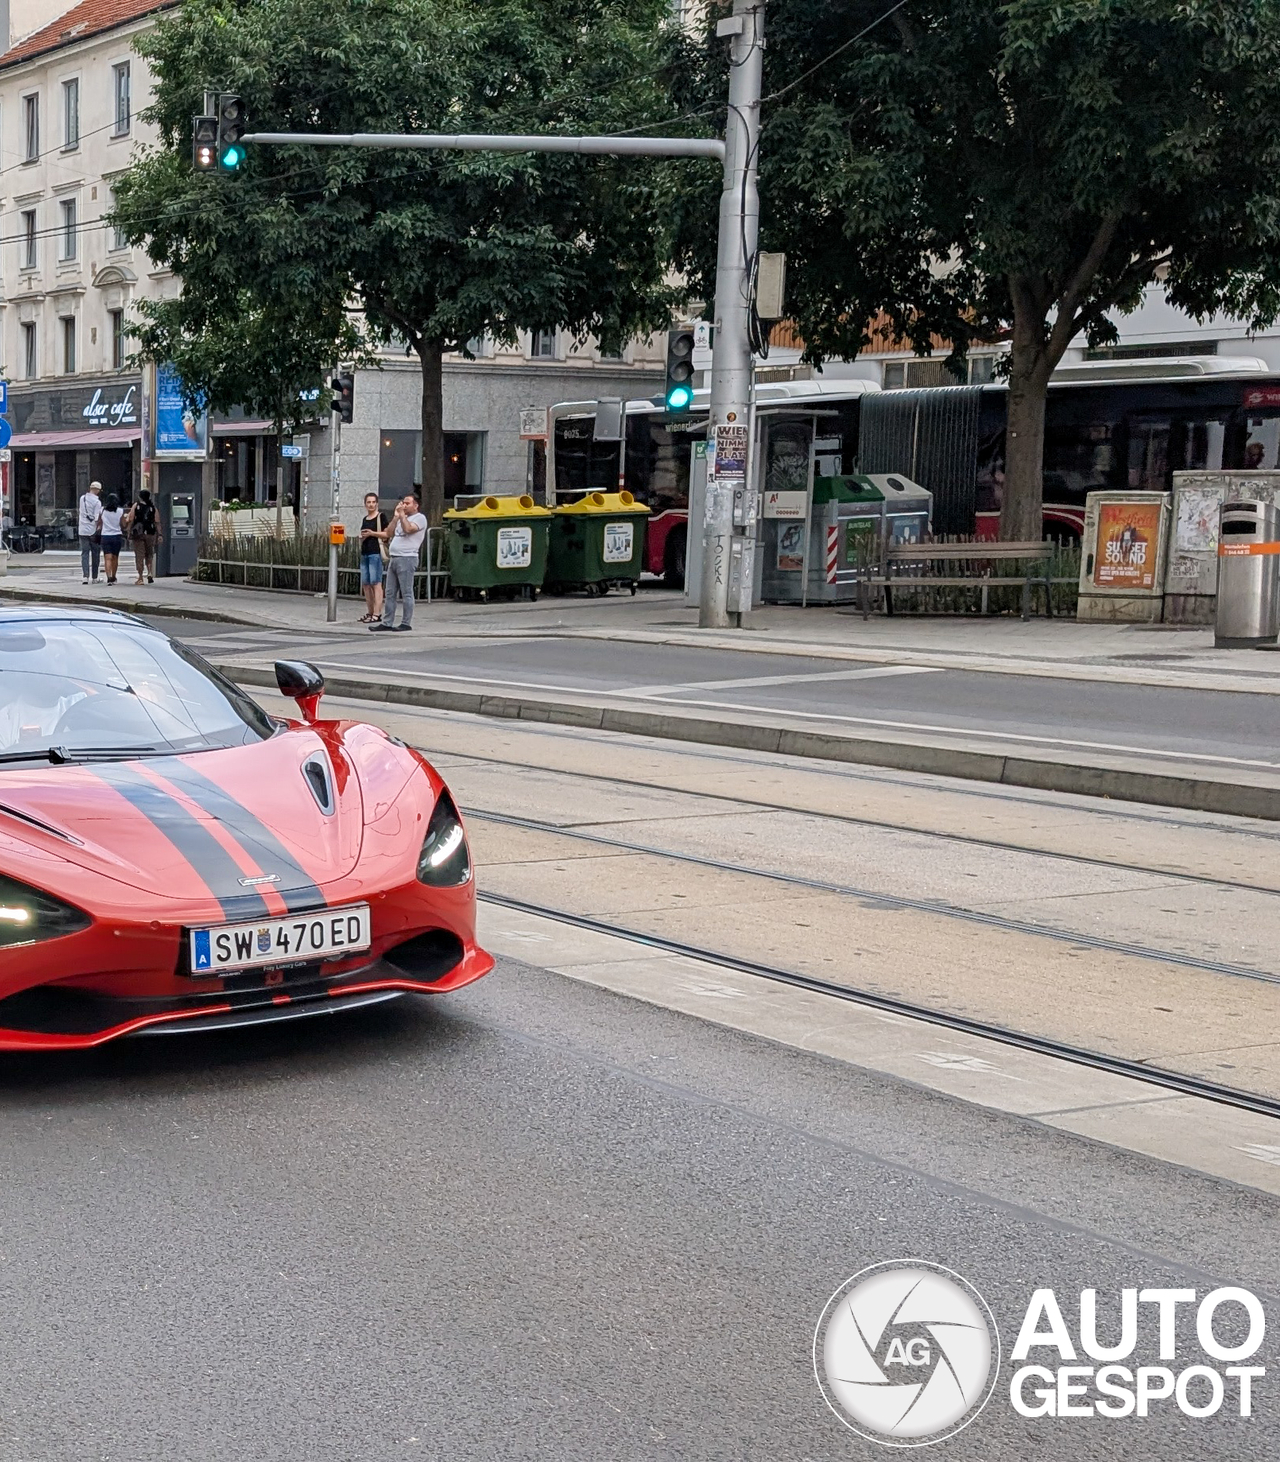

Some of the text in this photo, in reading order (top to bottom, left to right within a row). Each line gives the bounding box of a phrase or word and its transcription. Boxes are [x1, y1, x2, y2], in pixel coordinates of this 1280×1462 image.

[83, 389, 108, 416] alser
[1106, 541, 1147, 553] SUSET
[216, 916, 360, 962] SW 470 ED
[198, 954, 207, 964] A
